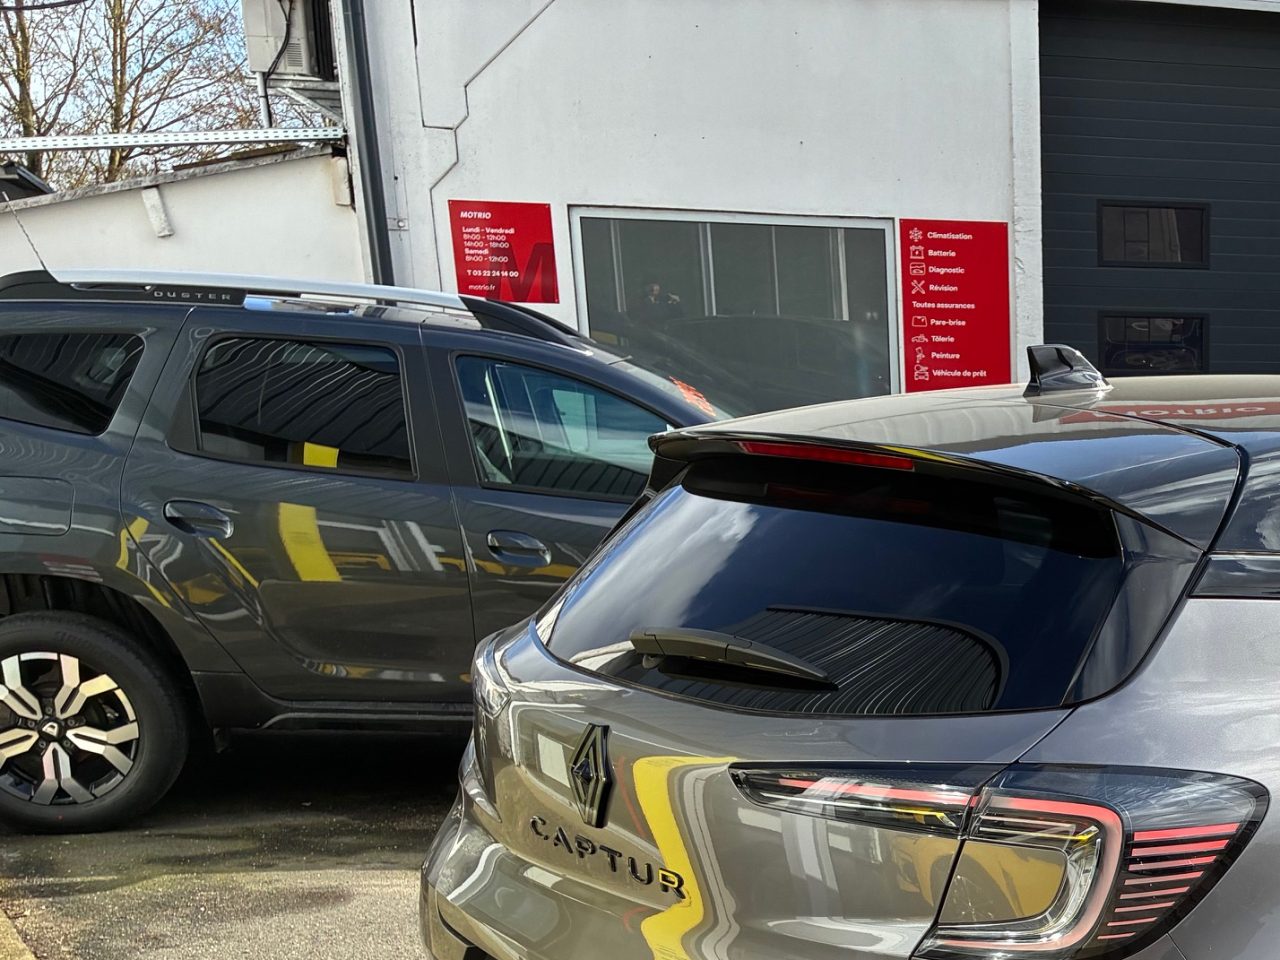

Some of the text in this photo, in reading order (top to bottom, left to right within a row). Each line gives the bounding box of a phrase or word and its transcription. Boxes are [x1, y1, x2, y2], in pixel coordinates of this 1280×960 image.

[460, 211, 492, 219] MOTRIO
[927, 231, 973, 240] Climatisation
[928, 249, 956, 257] Batterie
[928, 266, 965, 275] Diagnostic
[153, 291, 231, 300] DUSTER
[932, 369, 987, 378] Véhicule de prêt
[530, 815, 686, 899] CAPTUR
